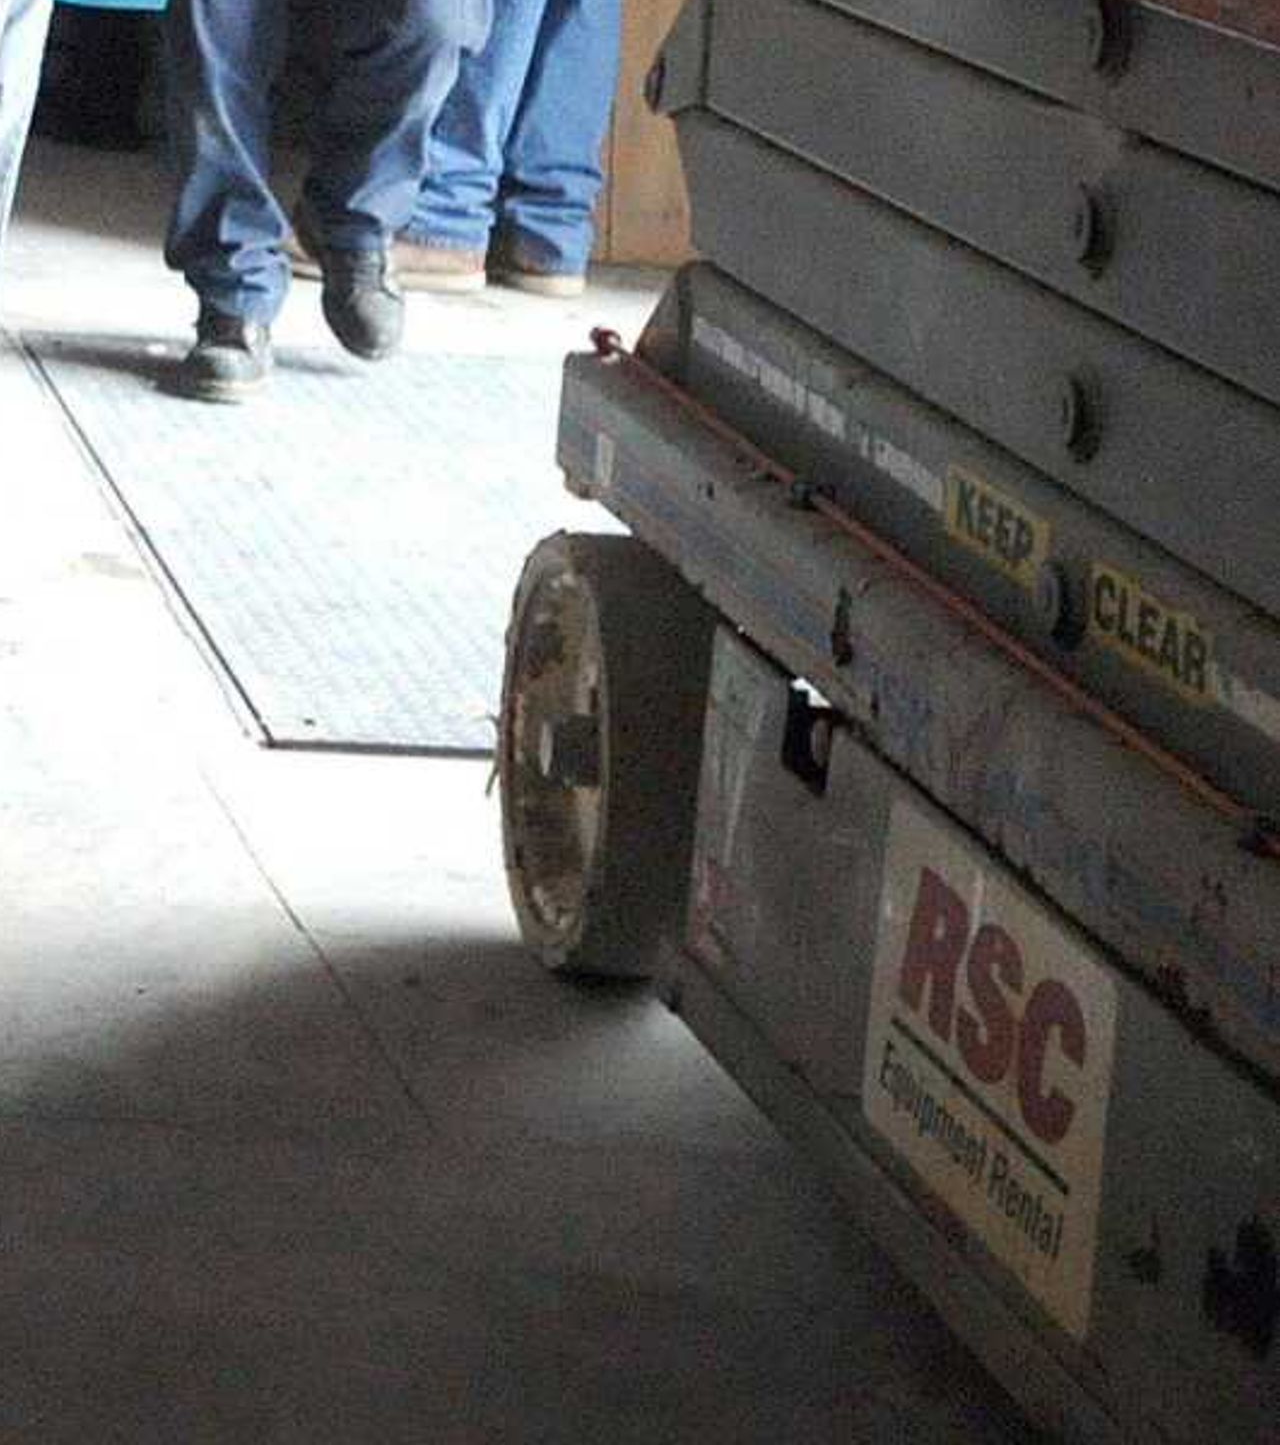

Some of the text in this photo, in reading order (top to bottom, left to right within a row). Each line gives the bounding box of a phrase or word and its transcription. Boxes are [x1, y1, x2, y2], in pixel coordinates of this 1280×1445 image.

[953, 479, 1207, 695] KEEP CLEAR
[899, 865, 1086, 1146] RSC
[878, 1040, 1064, 1262] Equipment Rental
